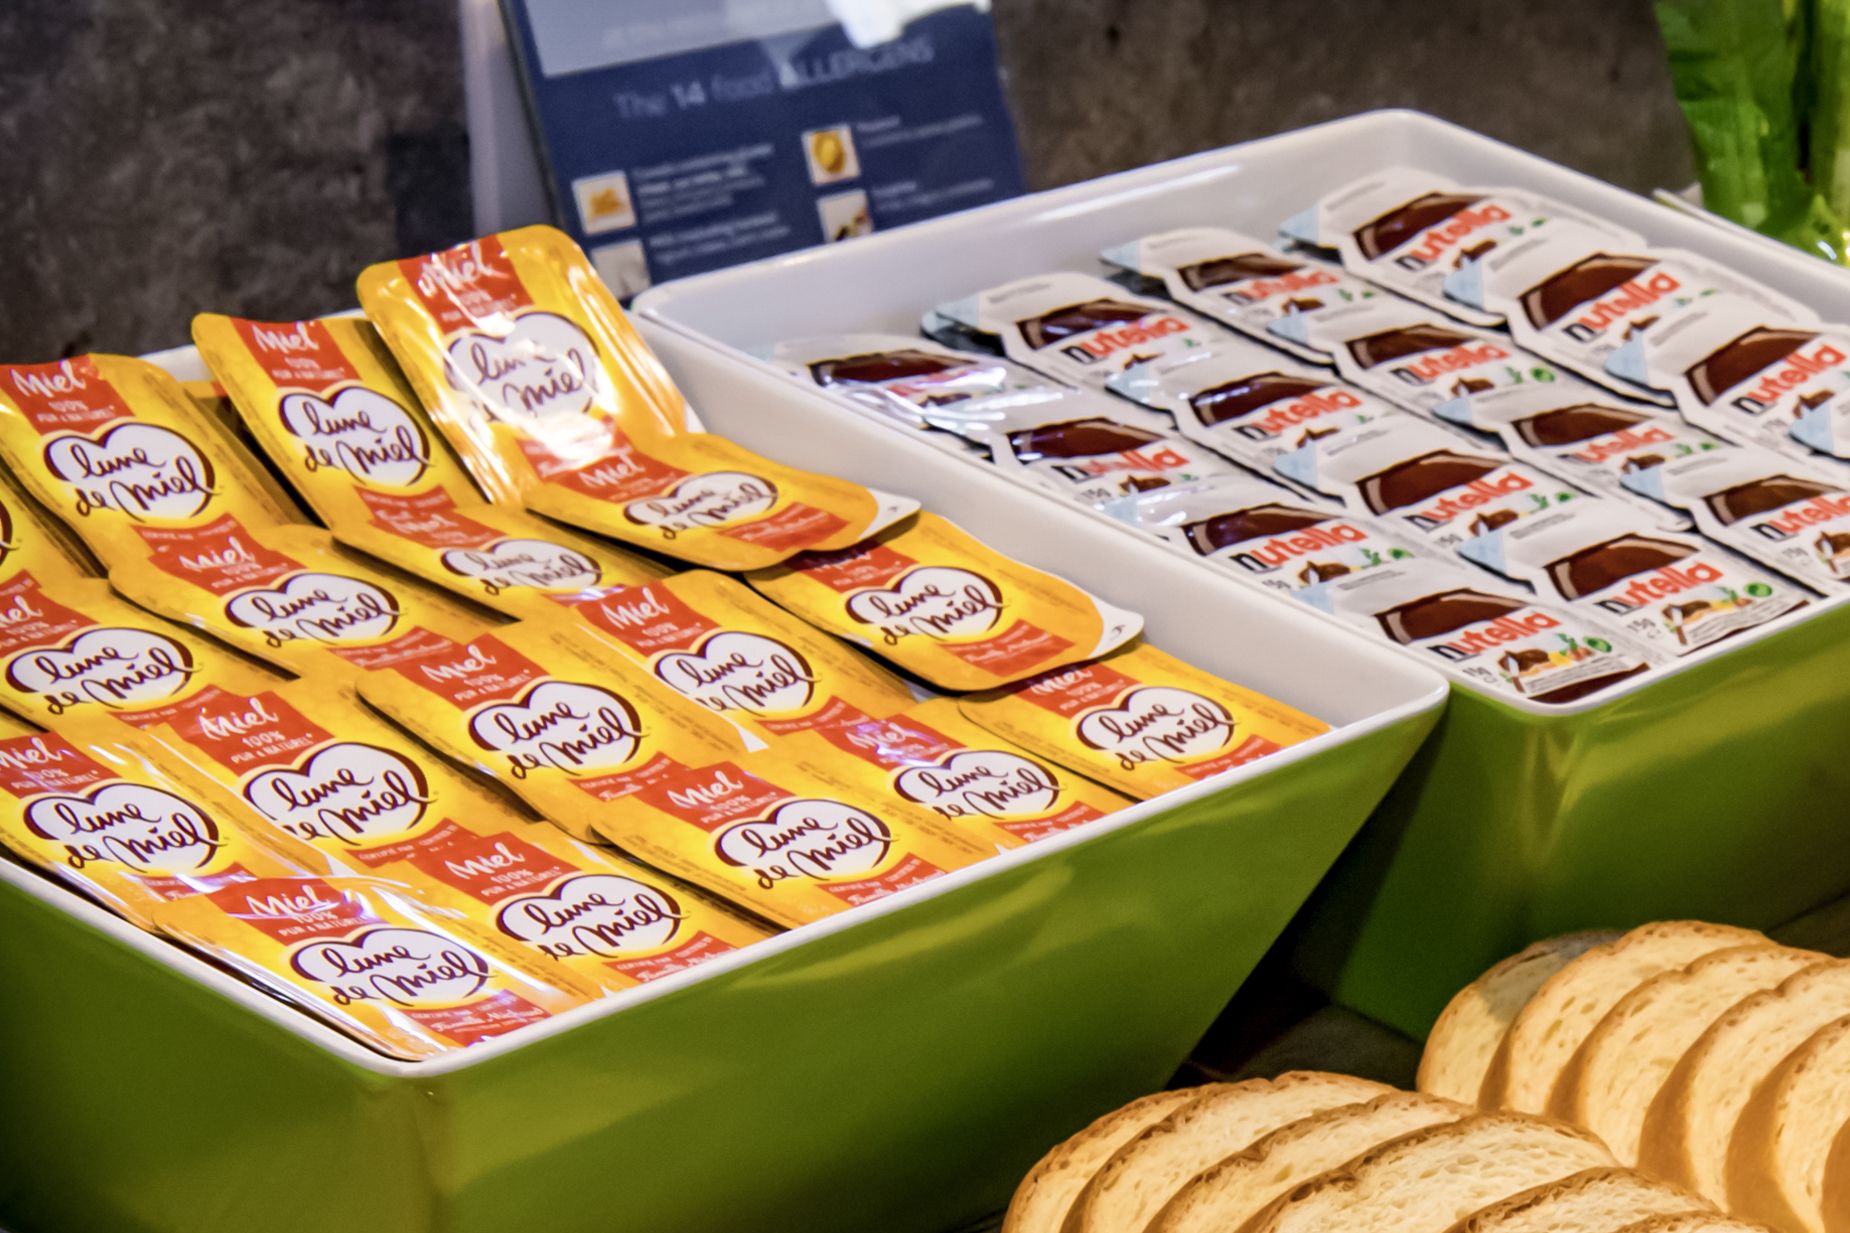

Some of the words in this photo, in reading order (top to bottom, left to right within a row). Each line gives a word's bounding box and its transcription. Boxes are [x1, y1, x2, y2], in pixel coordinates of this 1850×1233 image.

[1394, 203, 1512, 271] nutella
[1562, 272, 1682, 343] nutella
[251, 320, 320, 353] Miel
[1060, 317, 1190, 365] nutella
[10, 360, 87, 398] Miel
[1730, 344, 1847, 416] nutella
[1232, 391, 1363, 442] nutella
[578, 450, 646, 488] Miel
[1402, 472, 1535, 533] nutella
[178, 536, 255, 571] Miel
[1229, 524, 1369, 574] nutella
[600, 586, 670, 629] Miel
[1594, 562, 1725, 616] nutella
[0, 595, 44, 628] iel
[1426, 612, 1562, 663] nutella
[420, 644, 498, 683] Miel
[199, 697, 280, 741] Miel
[231, 752, 255, 764] PUR
[242, 731, 286, 747] 100%
[667, 770, 743, 808] Miel
[443, 841, 526, 880] Miel
[490, 867, 534, 885] 100%
[245, 885, 331, 917] Miel
[481, 884, 506, 896] PUR
[278, 925, 304, 937] PUR
